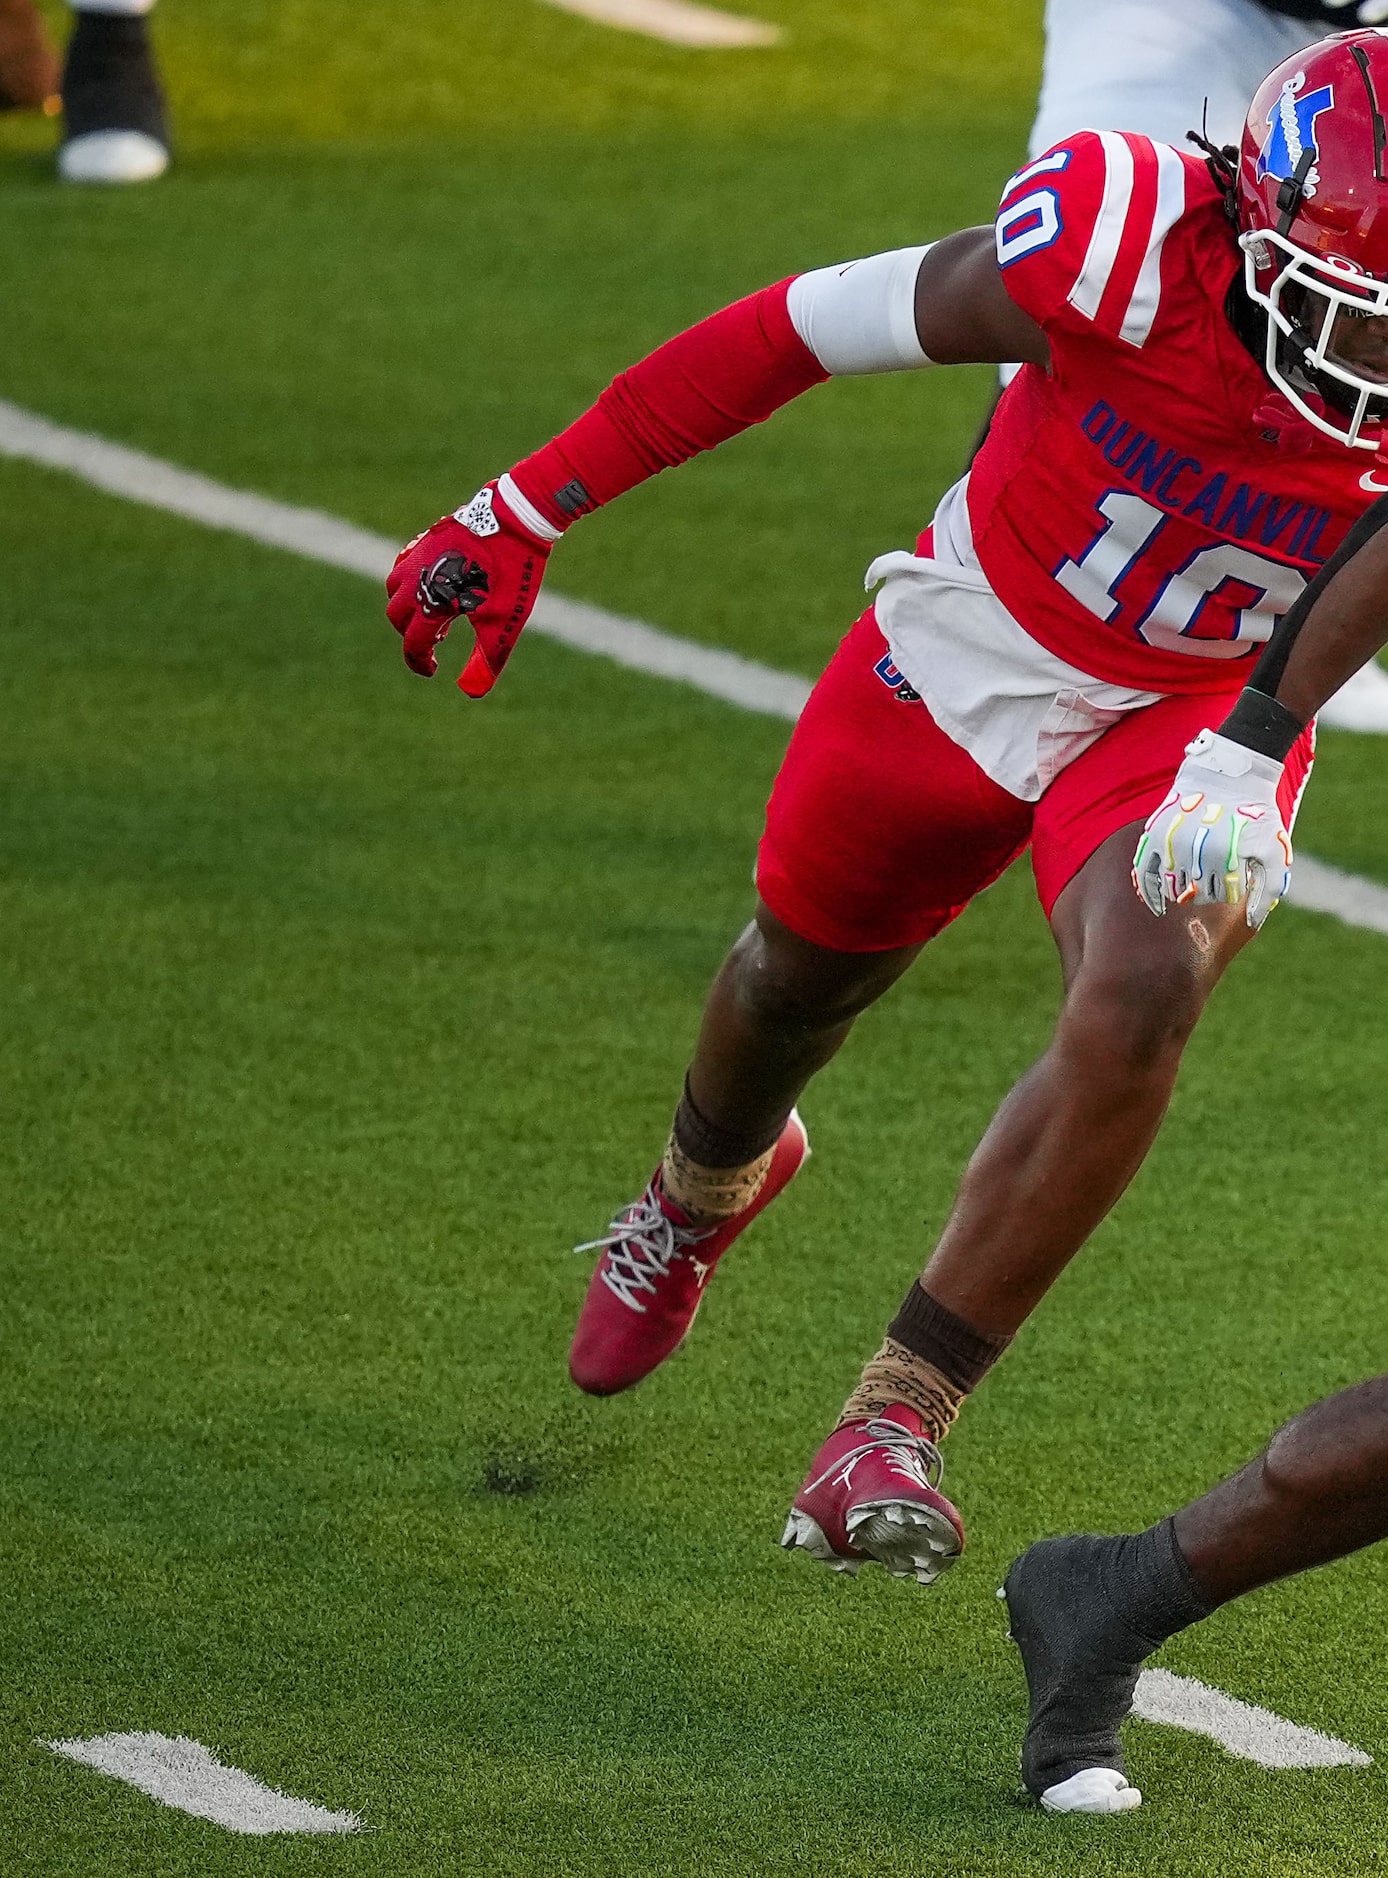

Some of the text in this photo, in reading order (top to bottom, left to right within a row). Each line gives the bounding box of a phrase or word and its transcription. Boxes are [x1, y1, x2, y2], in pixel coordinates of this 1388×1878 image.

[994, 148, 1074, 271] 10
[1080, 400, 1331, 563] DUNCANVIL
[1051, 487, 1310, 660] 10
